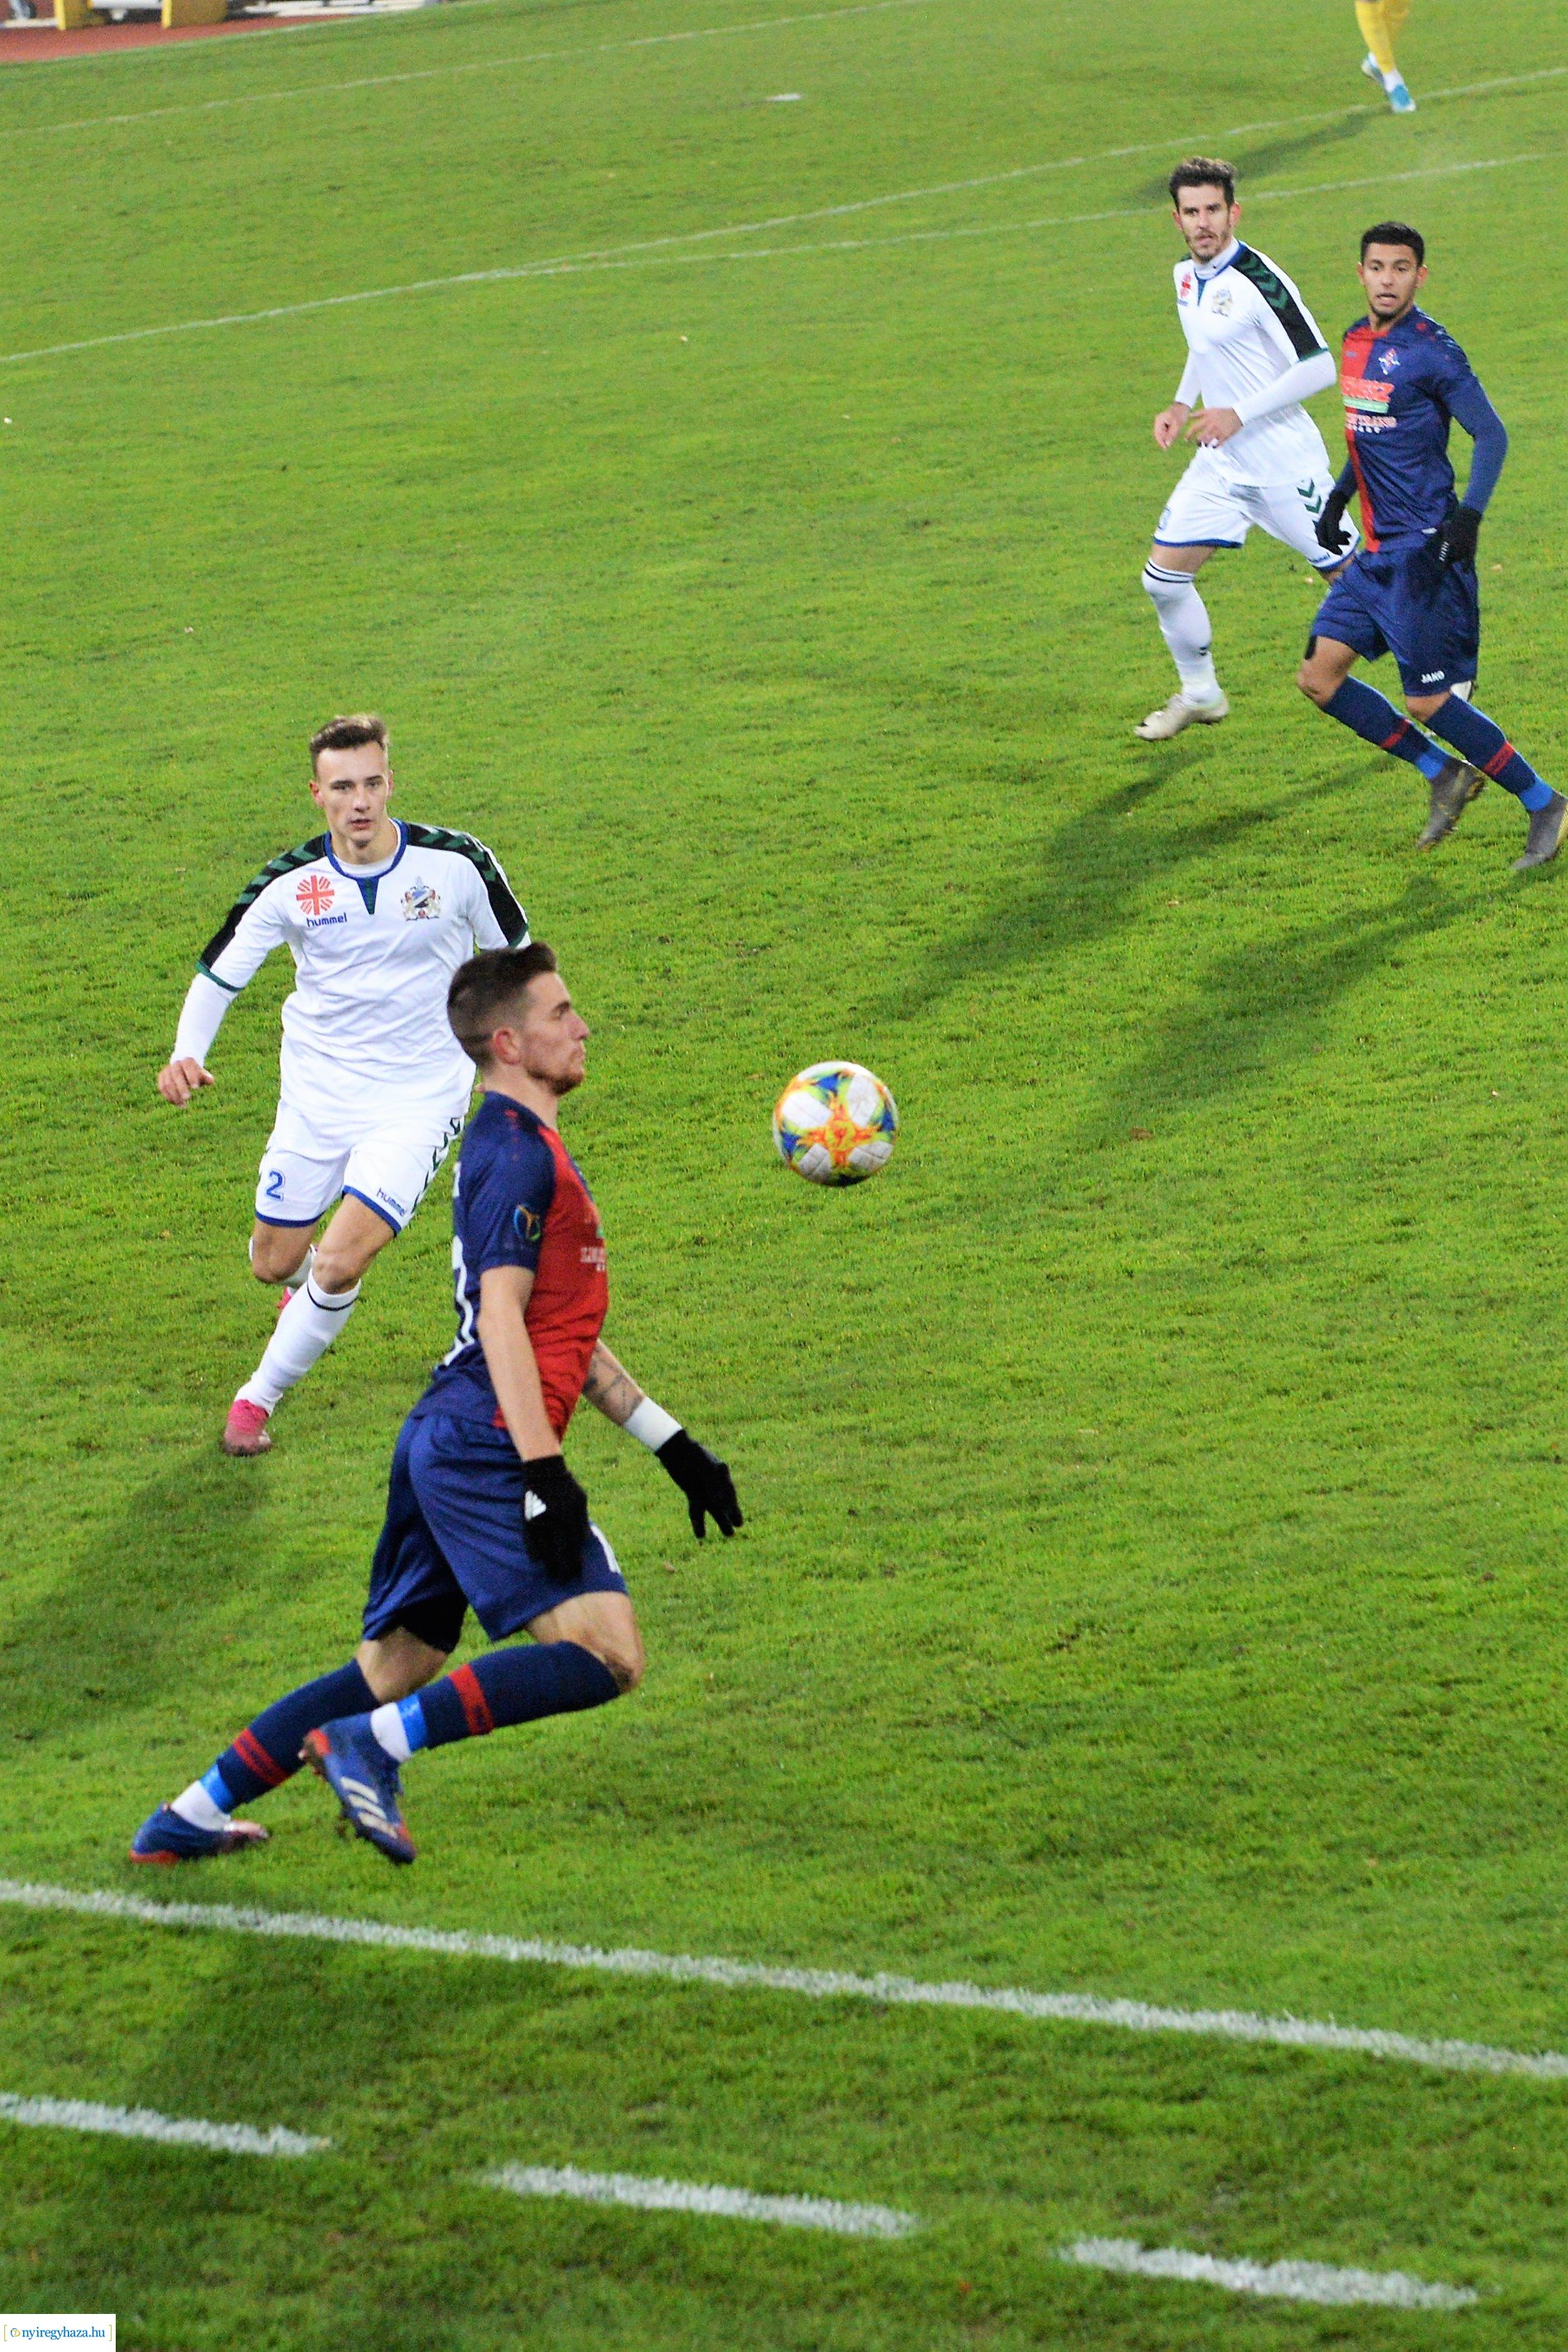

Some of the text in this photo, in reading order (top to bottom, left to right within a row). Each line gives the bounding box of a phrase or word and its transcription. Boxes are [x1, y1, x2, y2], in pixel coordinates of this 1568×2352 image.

[307, 912, 347, 927] hummel
[265, 1171, 284, 1199] 2
[376, 1187, 405, 1216] humme
